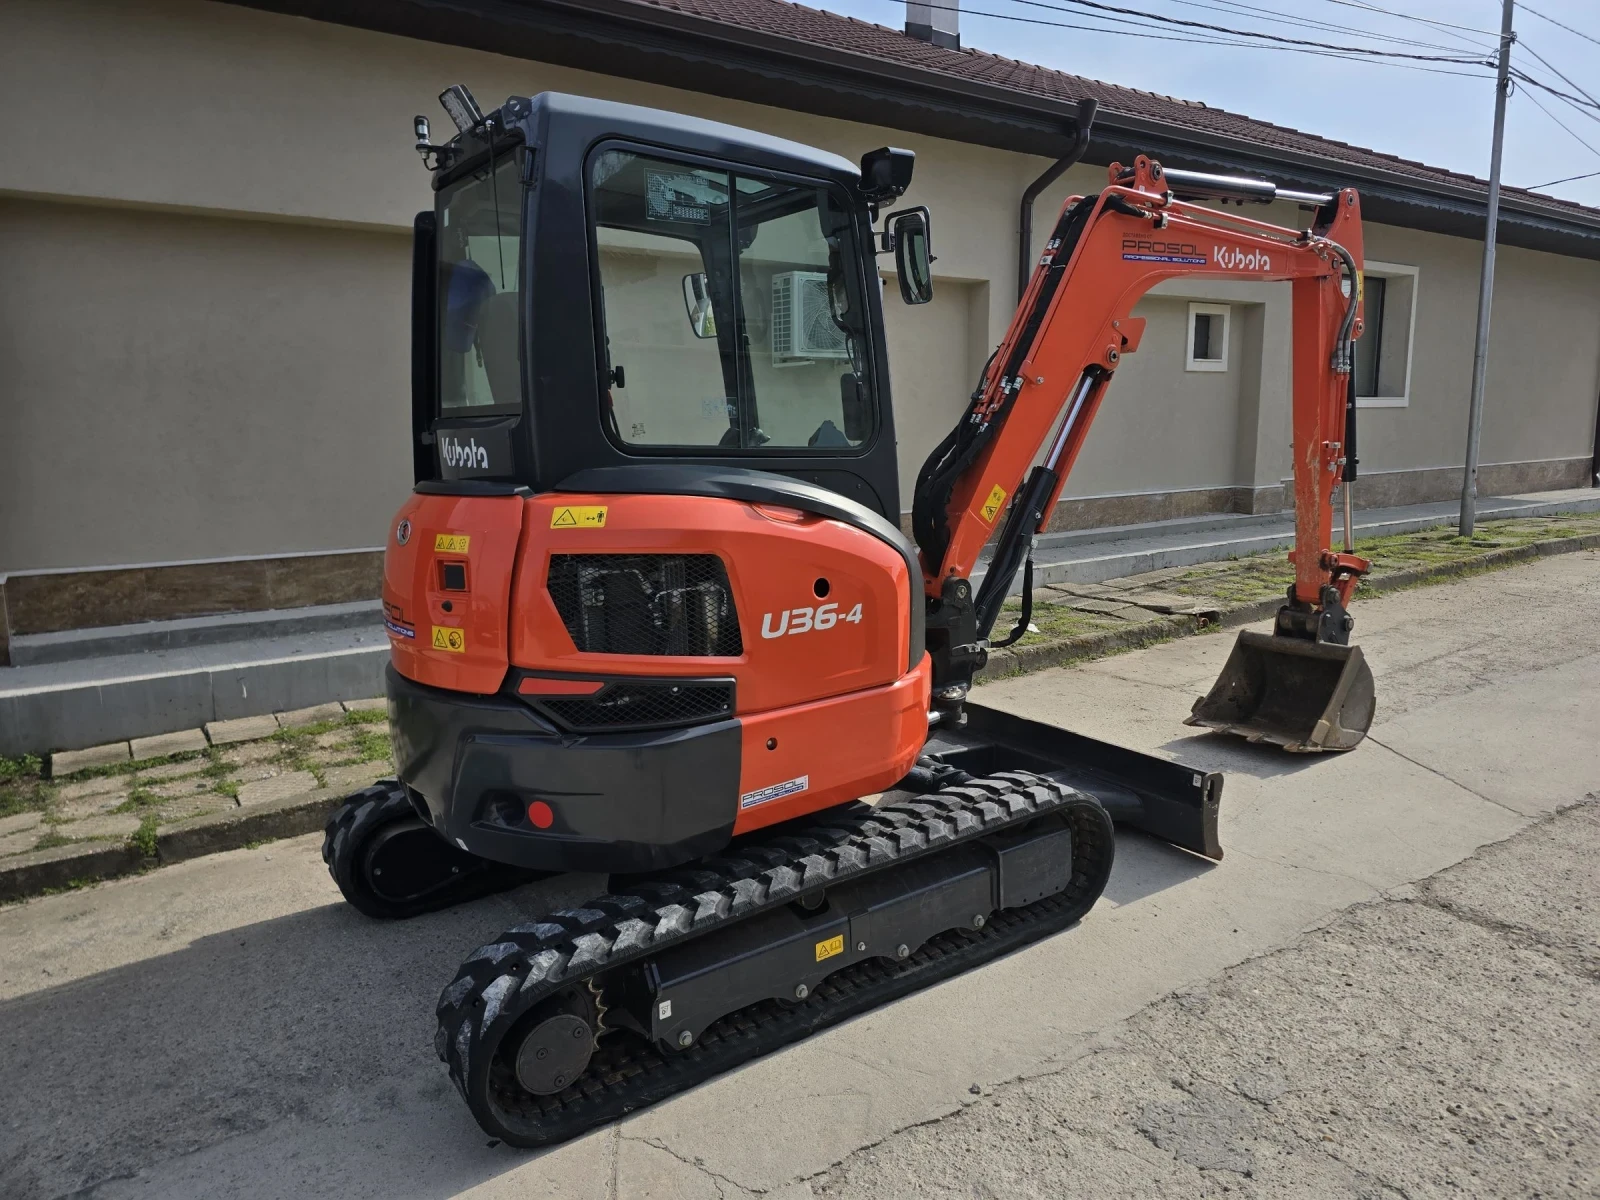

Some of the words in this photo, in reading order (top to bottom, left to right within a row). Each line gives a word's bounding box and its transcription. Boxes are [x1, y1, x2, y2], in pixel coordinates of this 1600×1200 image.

[1122, 240, 1207, 256] PROSOL
[1123, 254, 1171, 262] PROFESSIONAL
[1213, 246, 1271, 271] Kubota
[441, 437, 489, 469] Kubota
[761, 602, 863, 639] U36-4
[742, 780, 804, 803] PROSOL
